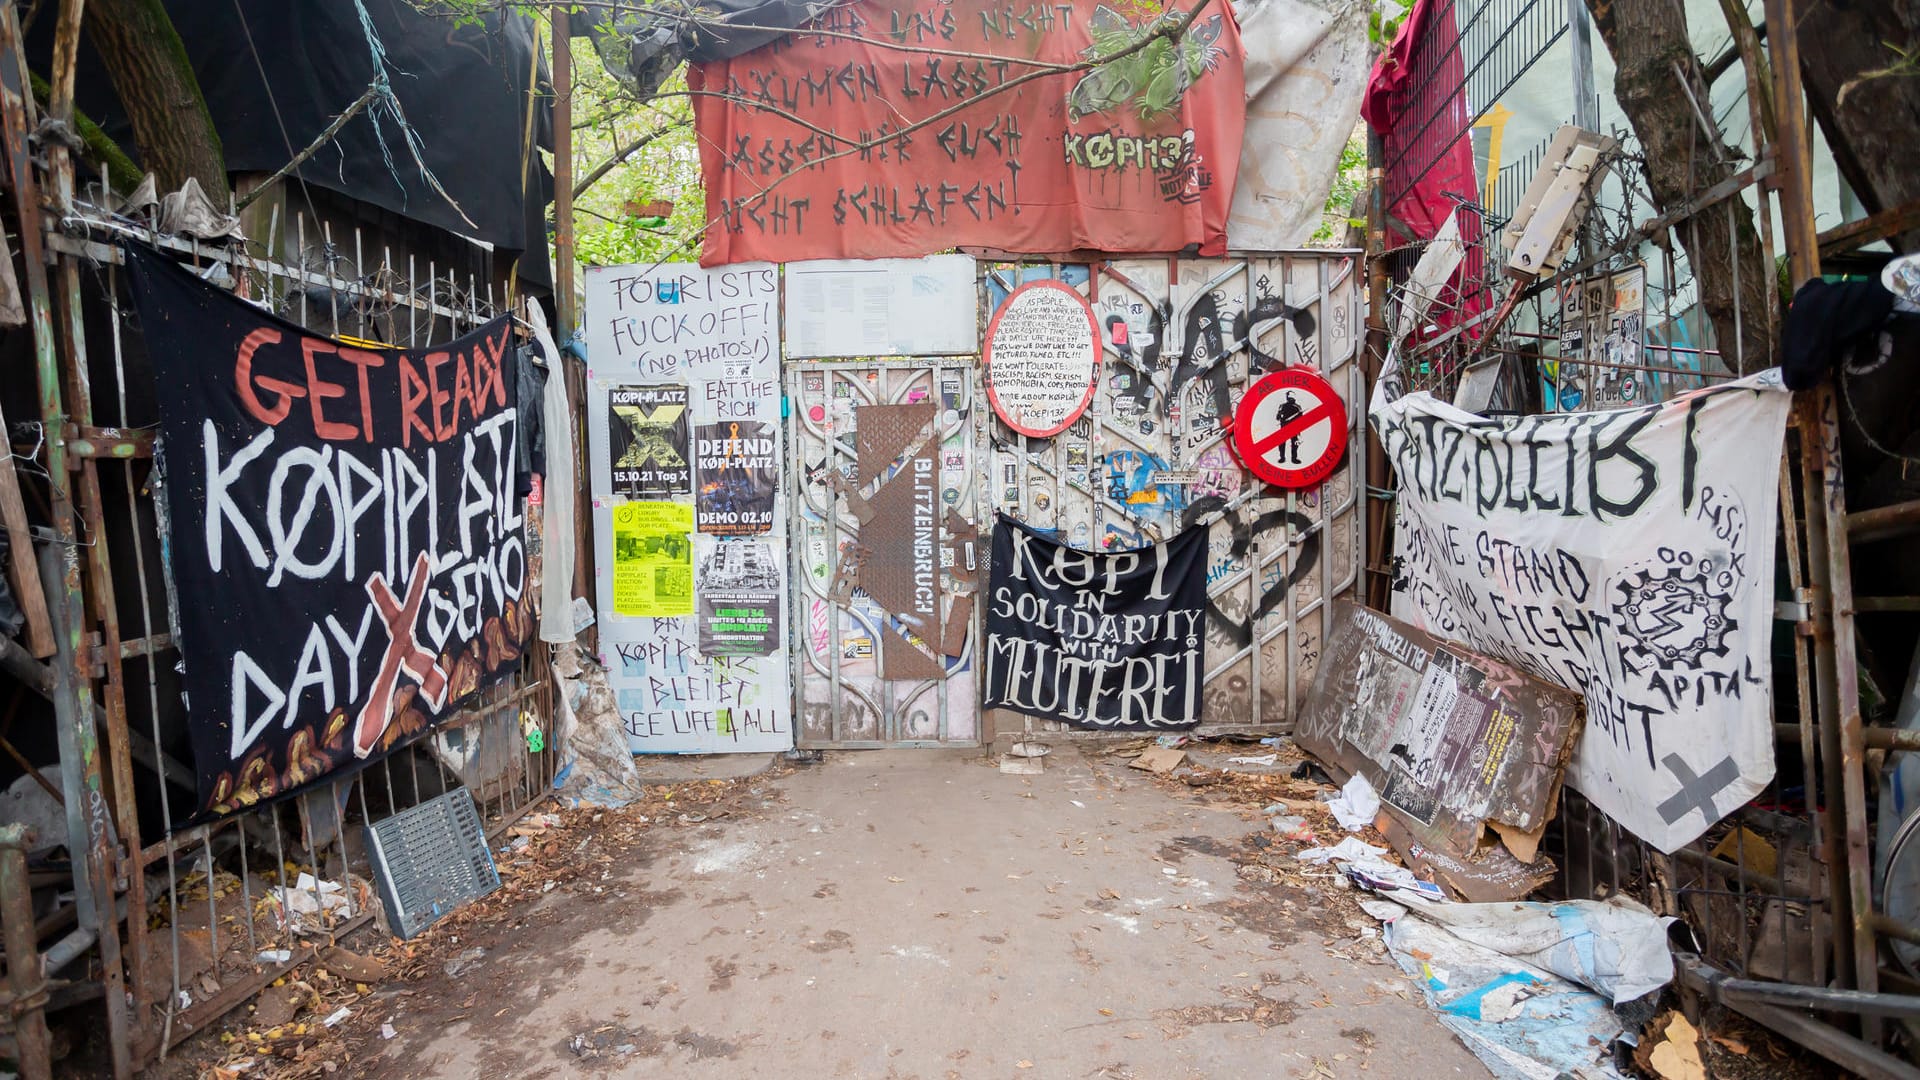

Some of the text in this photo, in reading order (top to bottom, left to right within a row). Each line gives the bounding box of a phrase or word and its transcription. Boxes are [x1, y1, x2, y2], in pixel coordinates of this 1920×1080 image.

[891, 7, 958, 43] UNS
[979, 4, 1074, 42] NICHT
[936, 113, 1022, 163] EUCH
[609, 269, 776, 311] TOURISTS
[610, 302, 770, 355] FUCK OFF!
[685, 336, 770, 369] PHOTOS!)
[235, 324, 511, 448] GET READY
[612, 390, 687, 404] KØPI-PLATZ
[706, 380, 773, 401] EAT THE
[1257, 374, 1312, 397] AB HIER
[717, 401, 756, 418] RICH
[699, 438, 773, 455] DEFEND
[699, 457, 773, 470] KØPI-PLATZ
[1258, 462, 1293, 483] KEINE
[1302, 441, 1340, 481] BULLEN
[613, 470, 688, 483] 15.10.21 Tag X
[699, 511, 772, 524] DEMO 02.10
[1008, 527, 1172, 601] KØPI
[1476, 530, 1591, 604] STAND
[991, 587, 1203, 645] SOLIDARITY
[1073, 589, 1105, 615] IN
[230, 535, 525, 760] DAY X DEMO
[1060, 637, 1118, 662] WITH
[1488, 591, 1614, 688] FIGHT
[984, 632, 1200, 728] MEUTEREI
[1617, 642, 1763, 714] KAPITAL
[621, 707, 787, 743] REE LIFE 4 ALL
